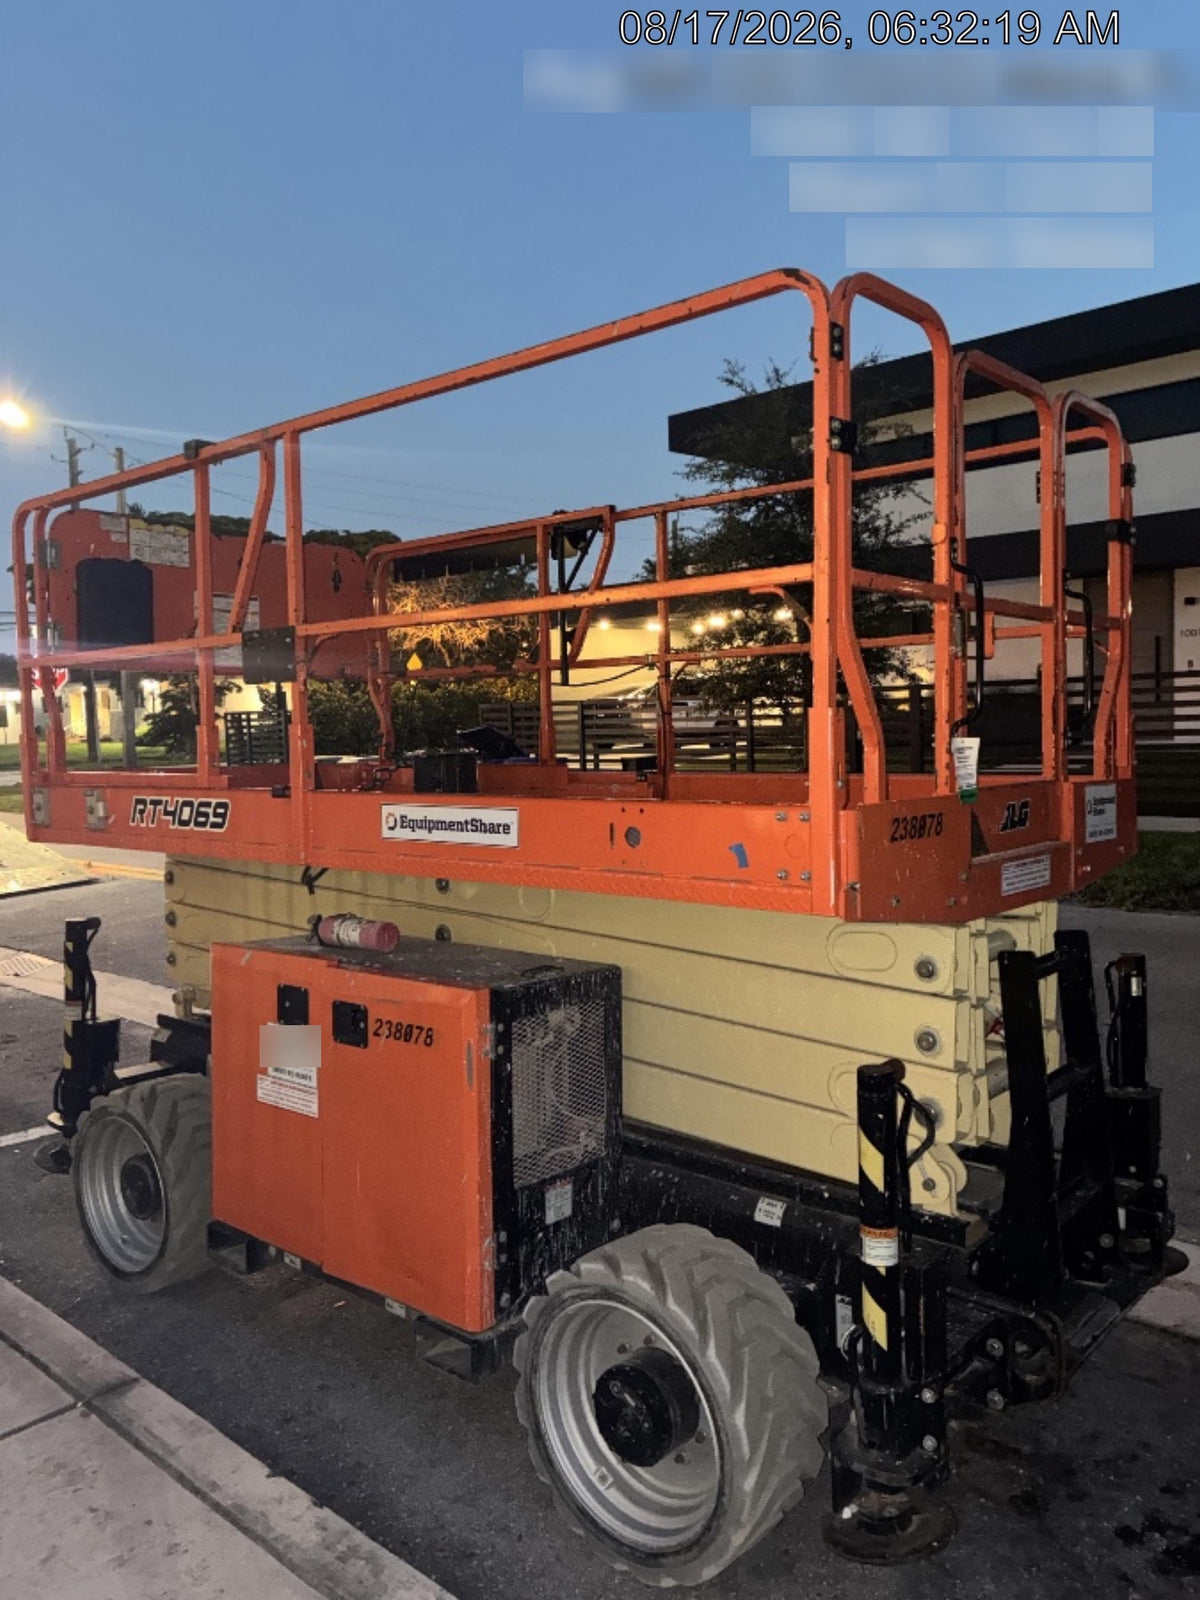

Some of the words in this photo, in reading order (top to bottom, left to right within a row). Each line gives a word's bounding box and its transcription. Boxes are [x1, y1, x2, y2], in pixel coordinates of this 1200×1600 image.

[130, 796, 231, 832] RT4069
[399, 813, 511, 835] EquipmentShare
[890, 812, 944, 843] 238078
[373, 1018, 433, 1047] 238078
